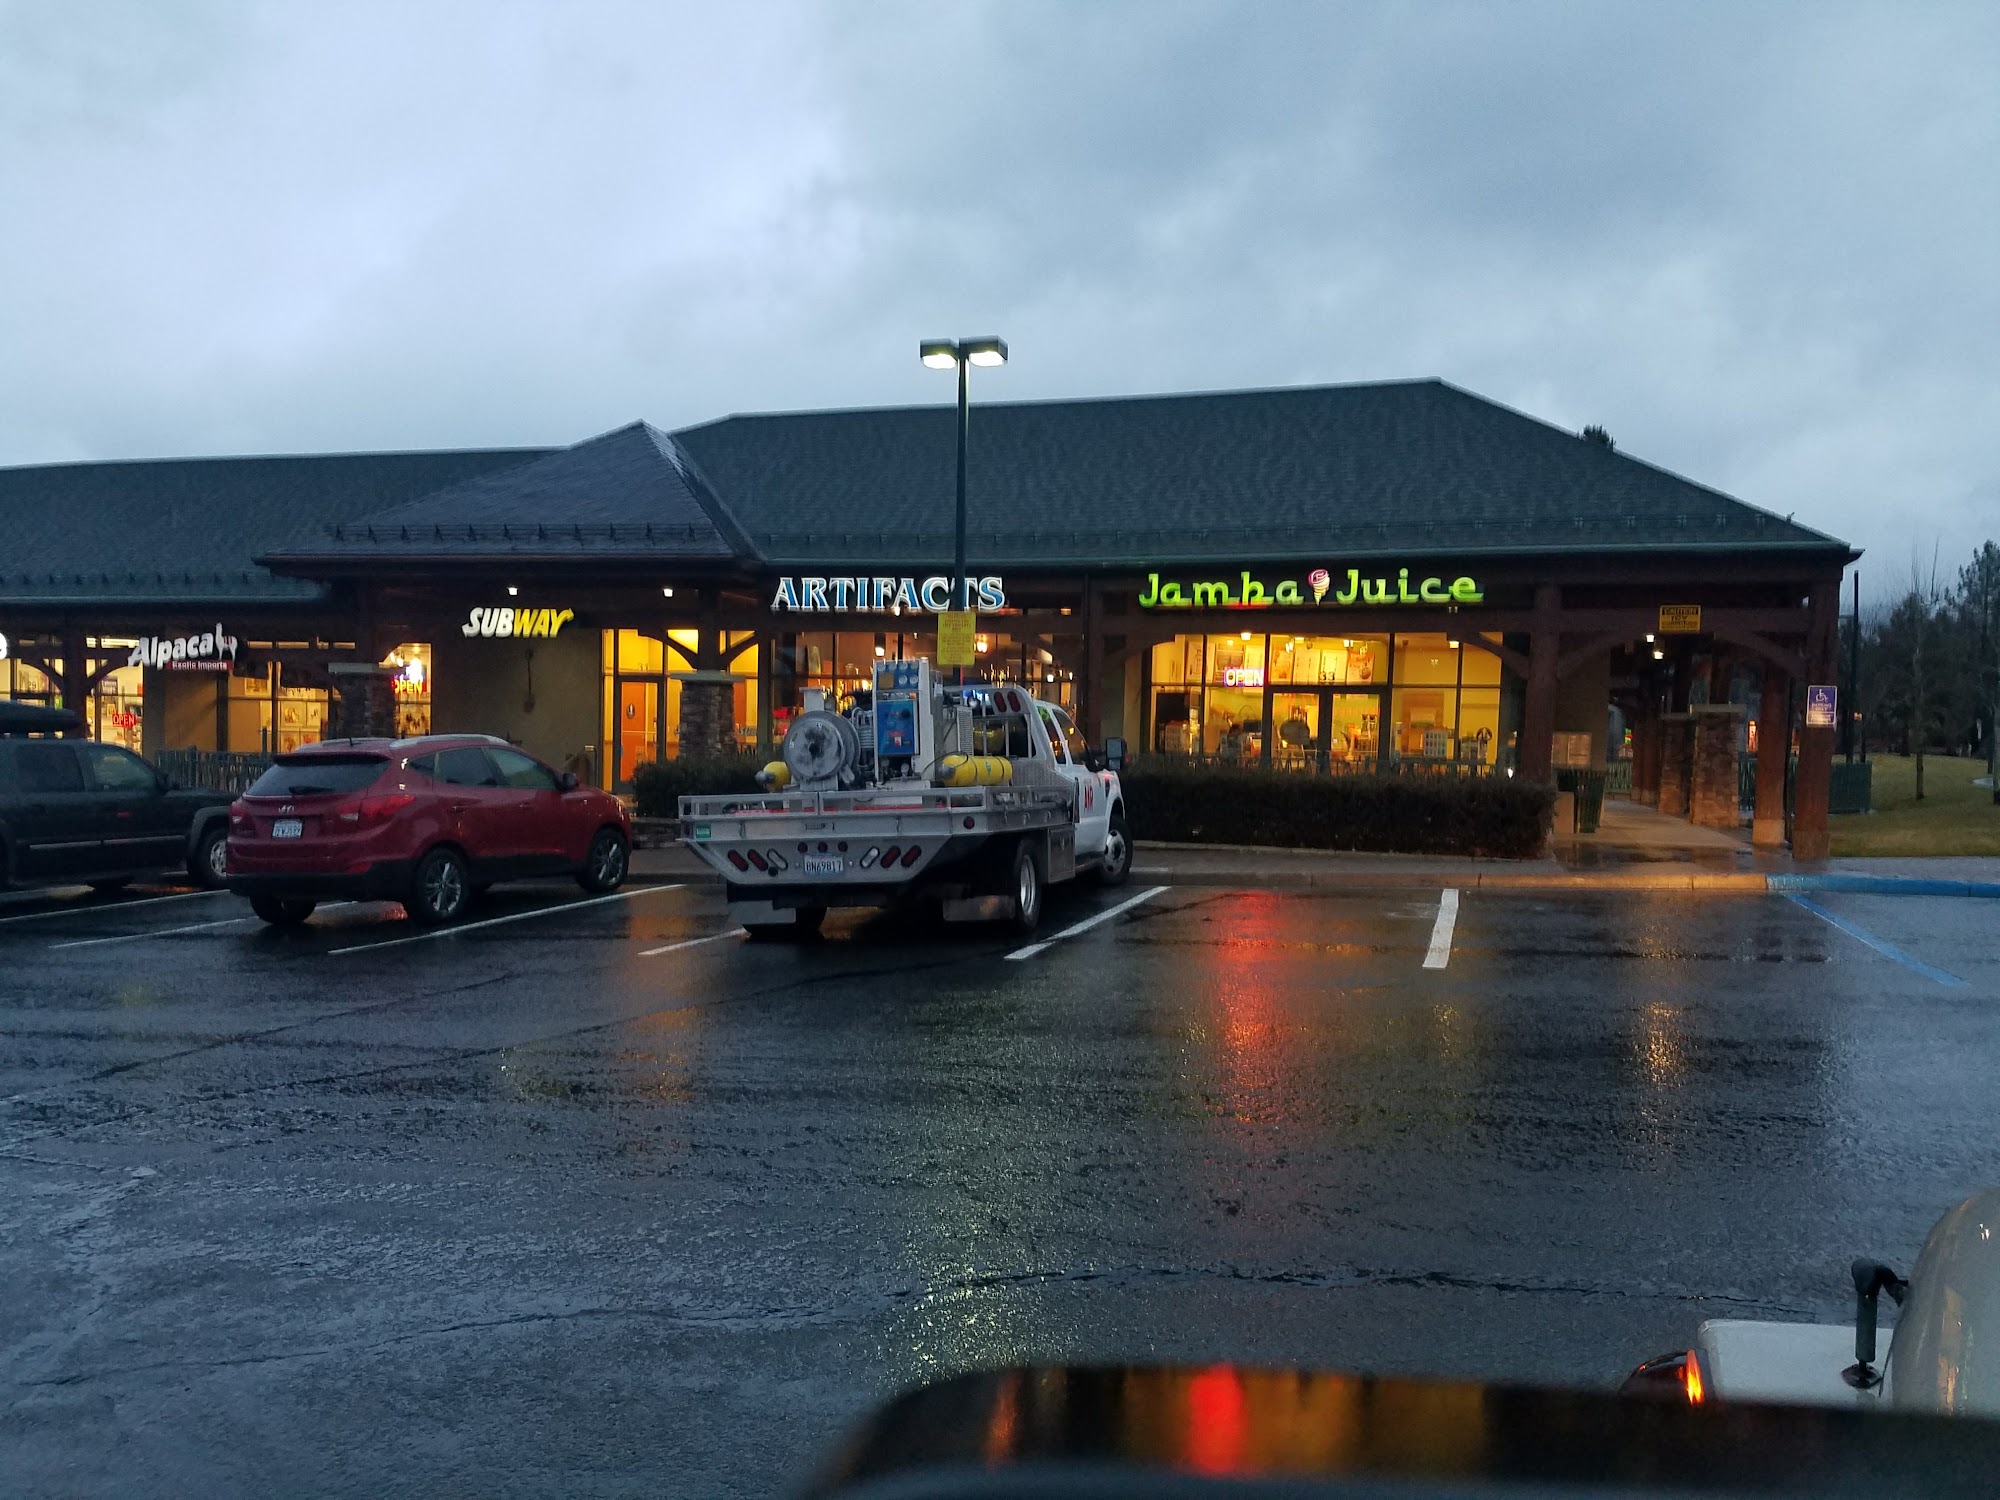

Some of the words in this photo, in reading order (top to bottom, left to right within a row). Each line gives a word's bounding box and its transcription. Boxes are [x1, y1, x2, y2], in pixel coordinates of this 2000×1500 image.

[770, 576, 1006, 612] ARTIFACTS
[1138, 571, 1304, 607] Jamba
[1336, 568, 1484, 604] Juice
[461, 607, 574, 638] SUBWAY
[1664, 607, 1697, 615] CAUTION
[127, 632, 214, 671] Alpaca
[391, 678, 423, 694] OPEN
[1226, 668, 1264, 687] OPEN
[113, 715, 137, 727] OPEN
